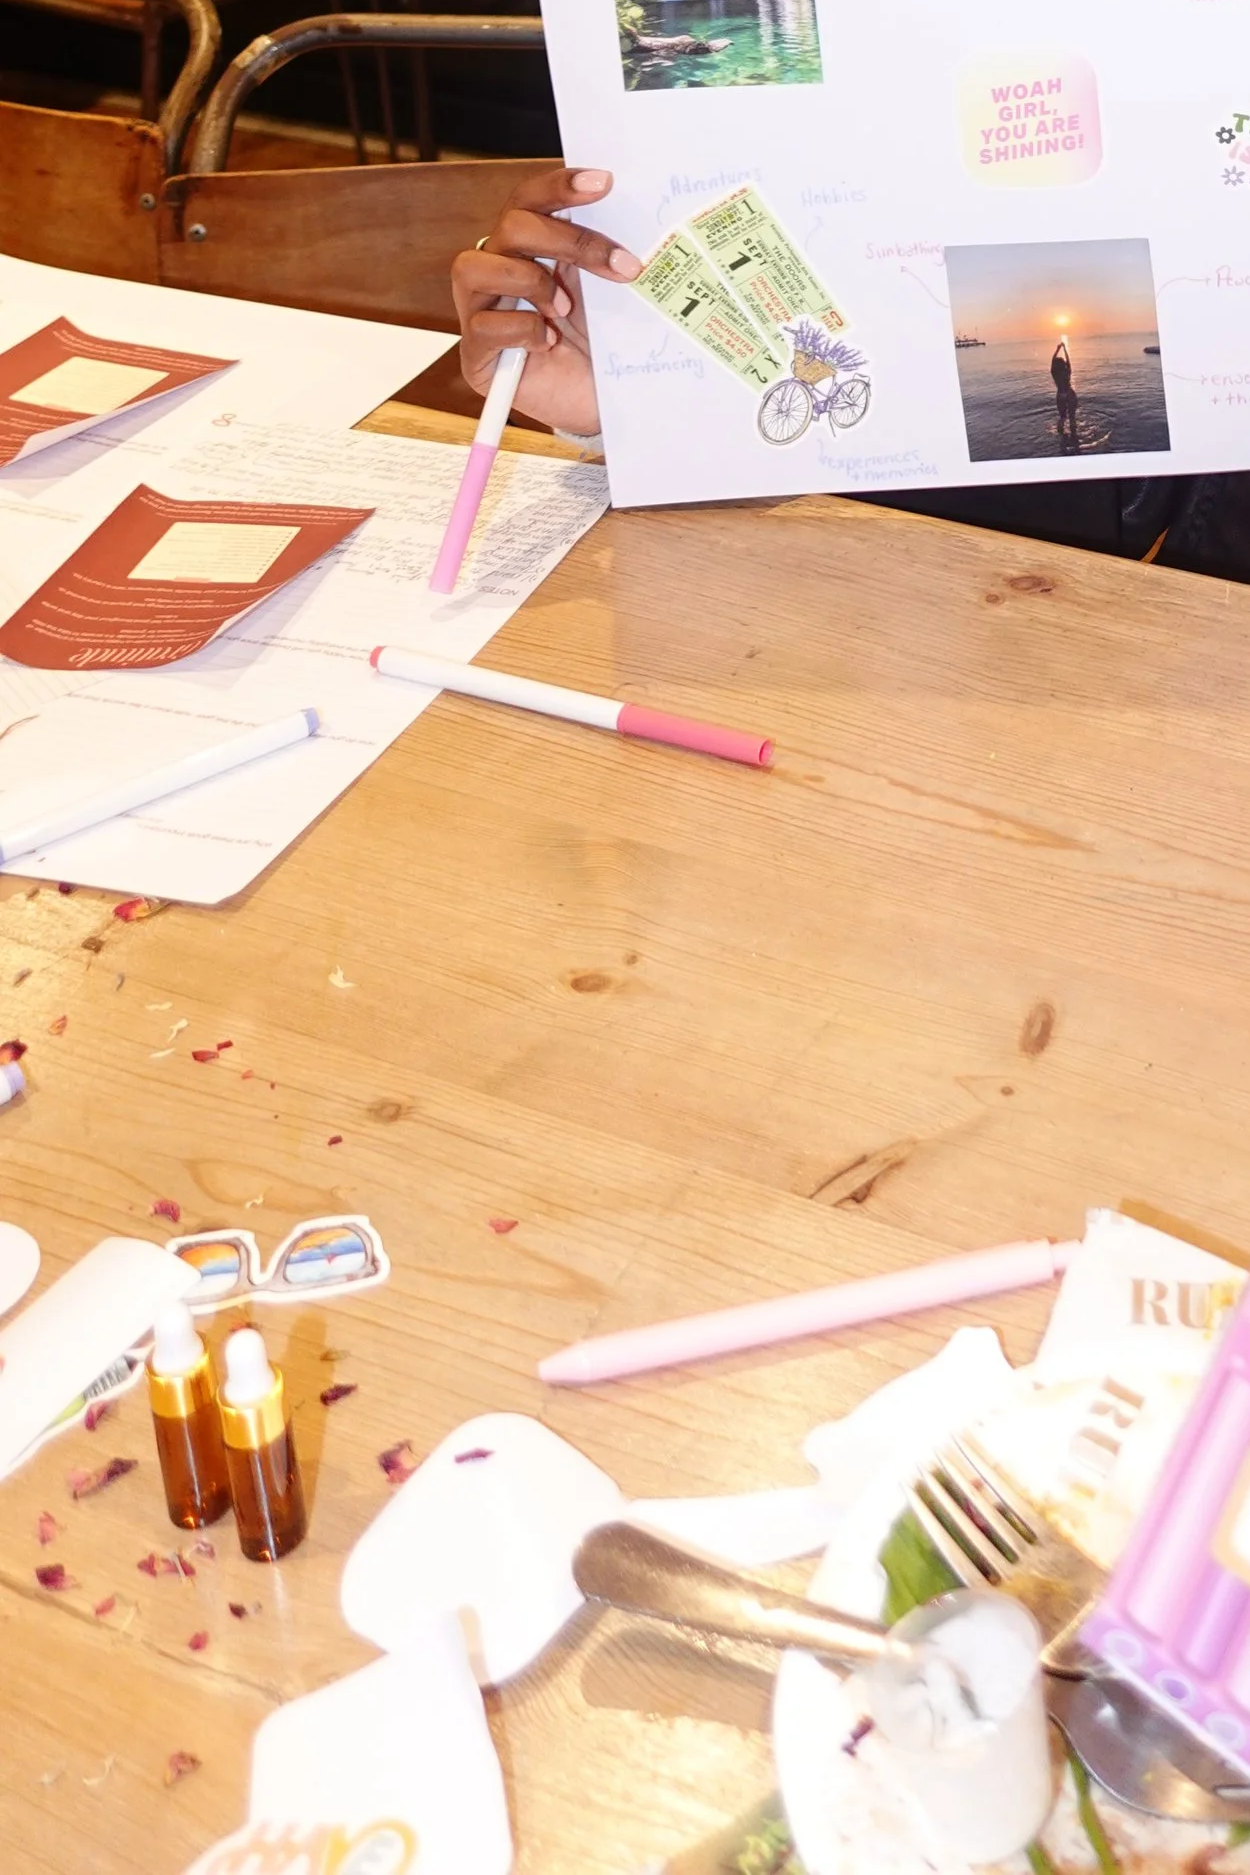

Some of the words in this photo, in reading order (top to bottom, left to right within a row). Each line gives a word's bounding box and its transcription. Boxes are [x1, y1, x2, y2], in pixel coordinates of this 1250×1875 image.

[991, 78, 1062, 104] WOAH
[998, 100, 1058, 122] GIRL,
[980, 123, 1027, 145] YOU
[1035, 114, 1080, 137] ARE
[979, 133, 1085, 165] SHINING!
[741, 197, 757, 216] 1
[800, 181, 869, 208] Hobbies
[706, 215, 743, 240] EVENING
[673, 242, 691, 260] 1
[729, 251, 752, 271] 1
[742, 237, 768, 268] SEPT
[865, 240, 945, 268] Sunbathing
[650, 261, 681, 293] EVENING
[771, 245, 786, 263] THE
[784, 263, 807, 292] DOORS
[686, 279, 716, 308] SEPT
[749, 281, 767, 302] Price
[755, 275, 793, 323] ORCHESTRA
[771, 274, 788, 295] ADMIT
[786, 295, 800, 311] ONE
[674, 293, 700, 319] 1
[709, 313, 755, 356] ORCHESTRA
[723, 310, 744, 329] ADMIT
[744, 328, 758, 341] ONE
[704, 321, 725, 341] Price
[724, 338, 747, 360] $4.50
[477, 584, 520, 598] NOTES
